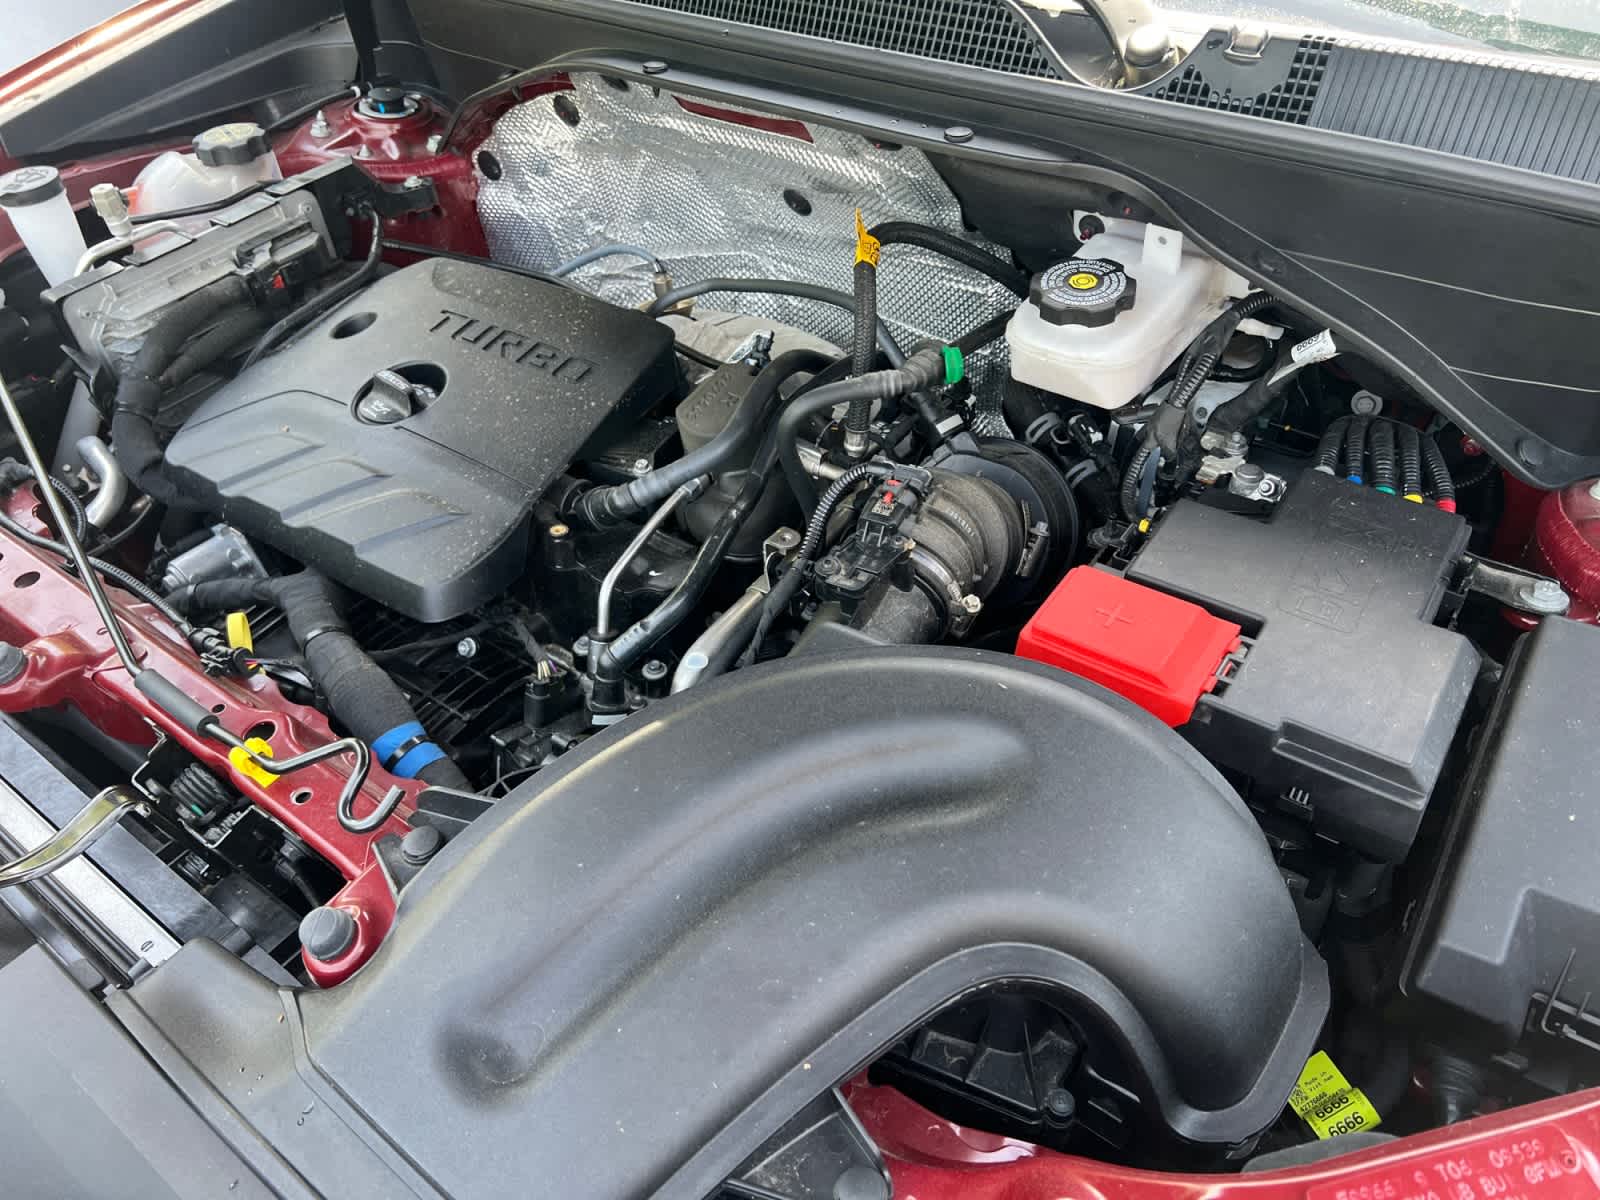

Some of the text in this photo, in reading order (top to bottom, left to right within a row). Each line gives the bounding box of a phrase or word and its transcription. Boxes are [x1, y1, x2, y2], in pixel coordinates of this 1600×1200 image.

[429, 309, 600, 382] TURBO
[1315, 1095, 1350, 1119] 6666
[1328, 1111, 1365, 1137] 6666
